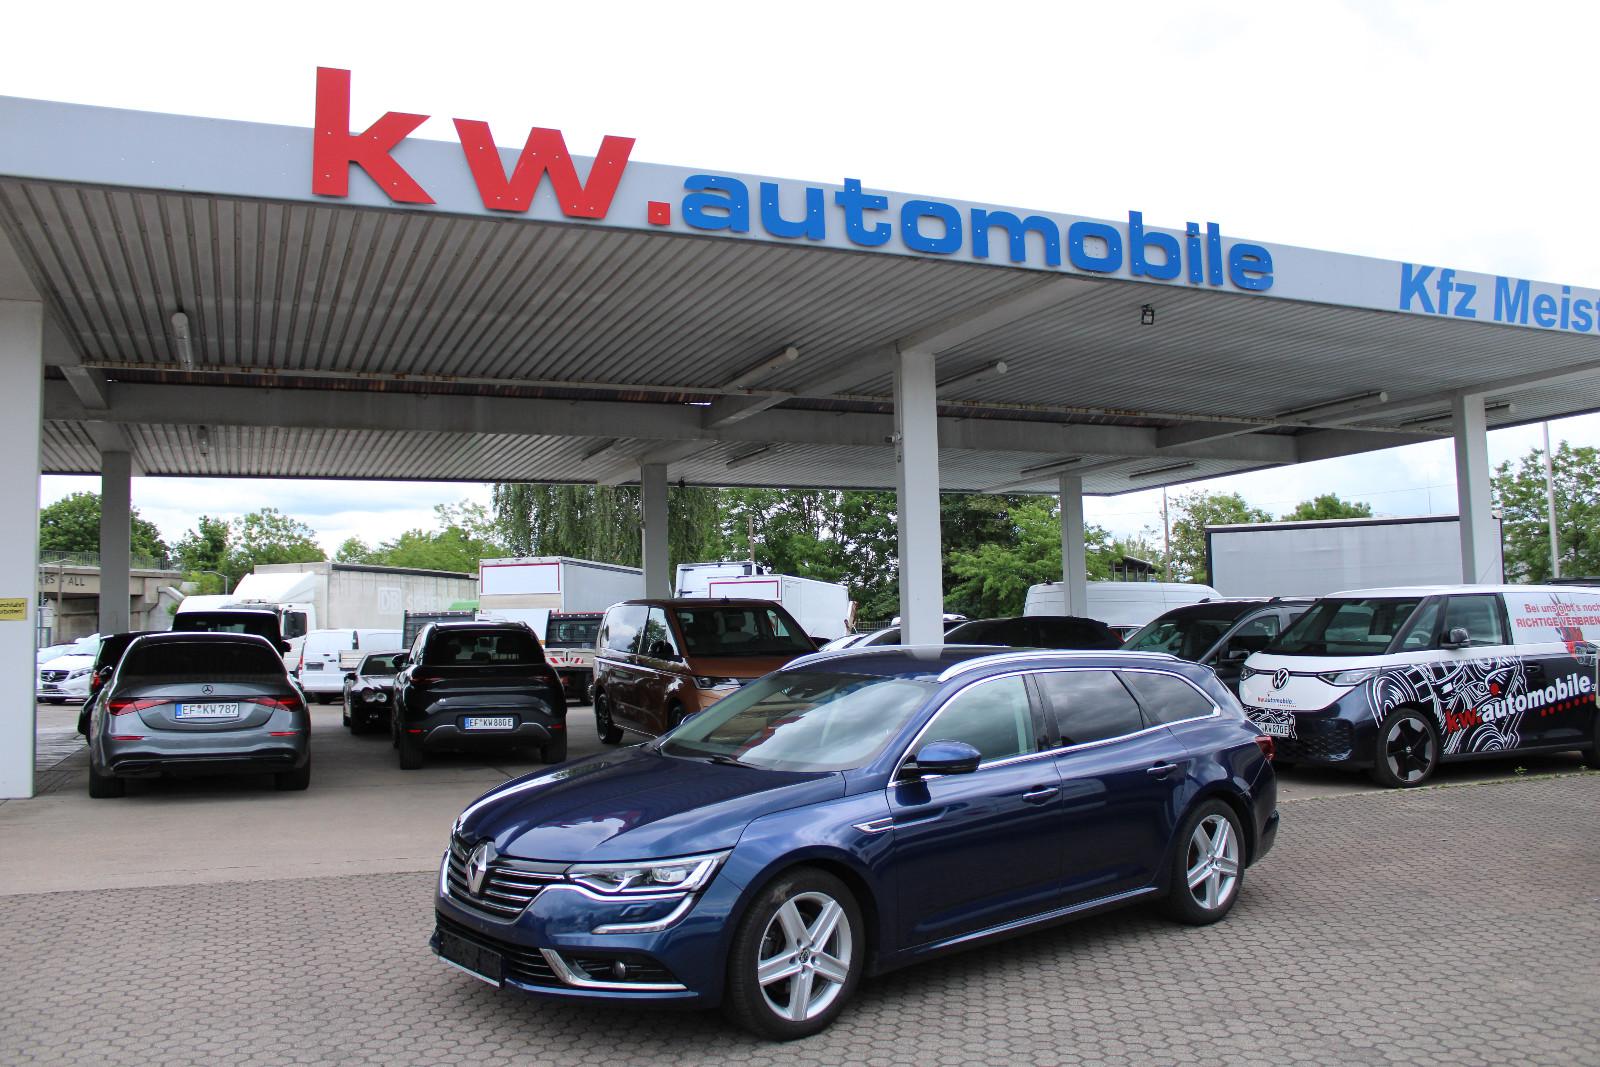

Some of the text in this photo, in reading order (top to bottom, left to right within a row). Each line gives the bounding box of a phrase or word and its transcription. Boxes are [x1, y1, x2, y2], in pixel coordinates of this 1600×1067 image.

[1399, 263, 1476, 318] Kfz
[1525, 604, 1539, 613] Bei
[1515, 617, 1559, 627] RICHTIGE
[182, 705, 196, 715] EF
